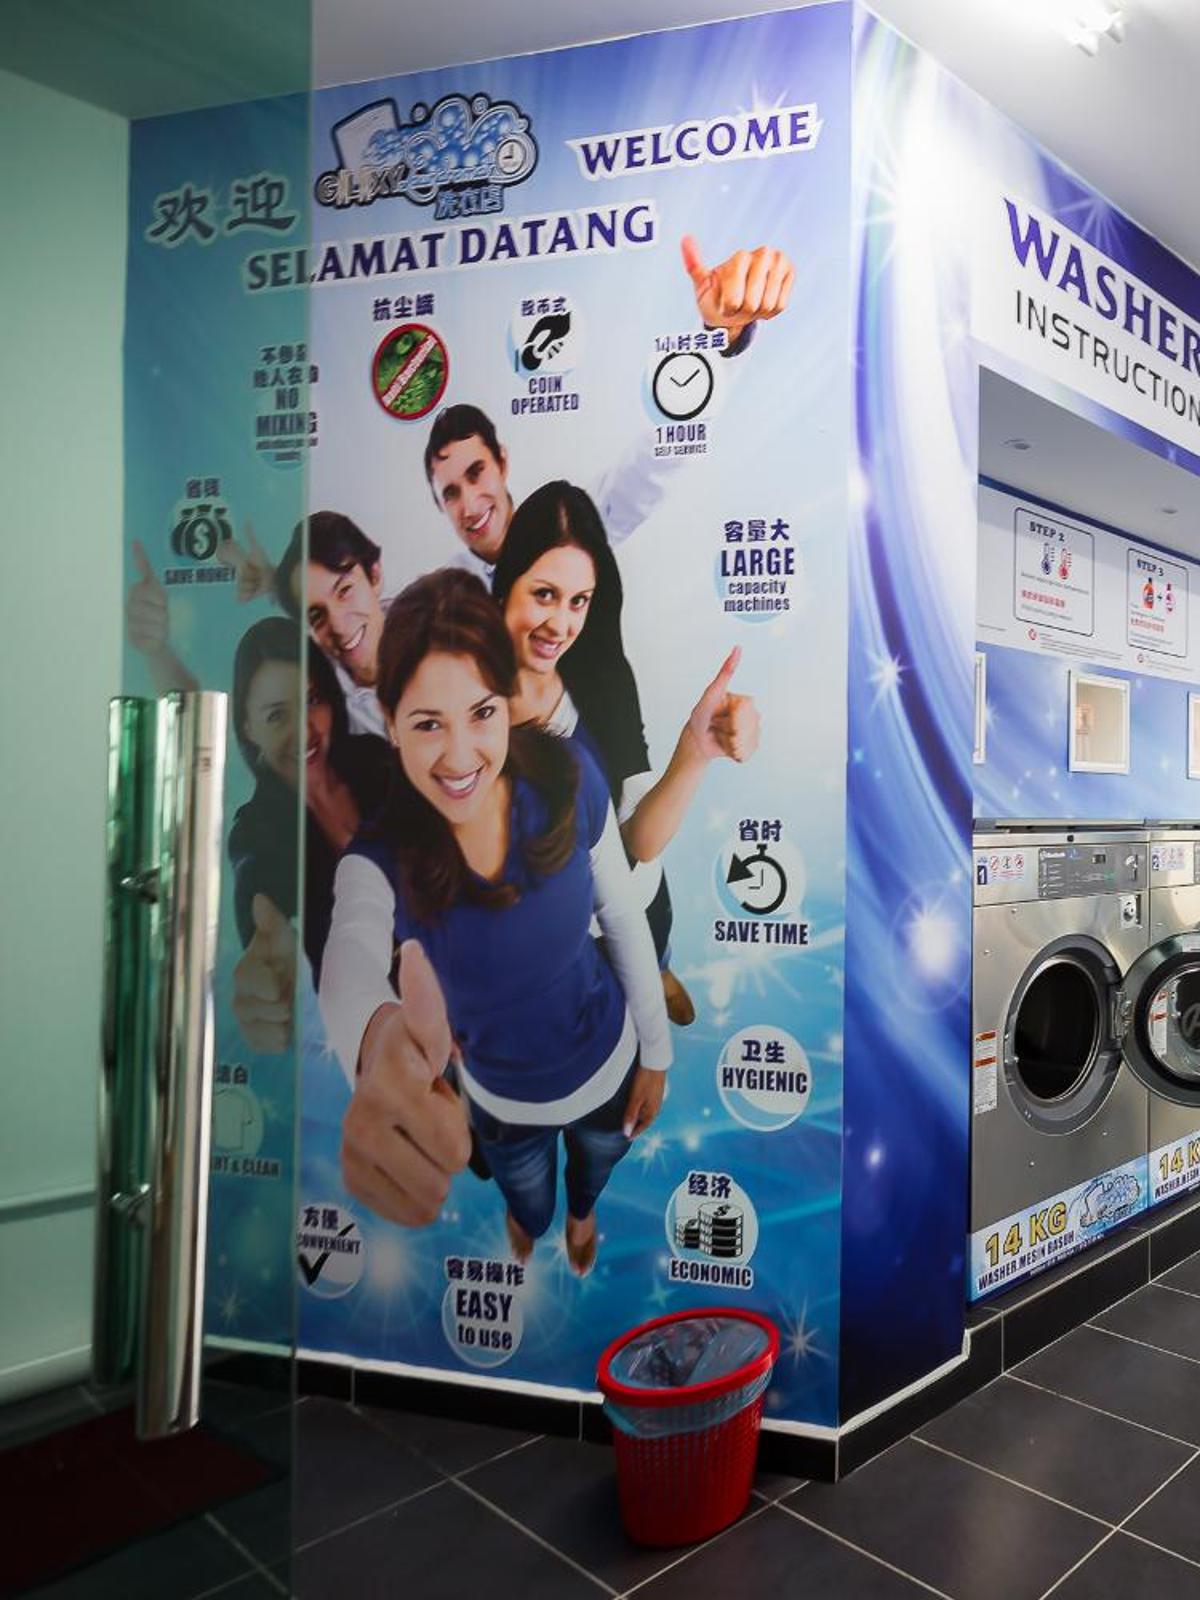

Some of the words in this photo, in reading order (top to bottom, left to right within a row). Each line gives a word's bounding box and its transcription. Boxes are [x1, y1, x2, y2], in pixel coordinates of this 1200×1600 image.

[580, 111, 811, 174] WELCOME
[150, 177, 295, 242] 欢迎
[247, 232, 446, 289] SELAMAT
[459, 206, 654, 265] DATANG
[529, 376, 562, 394] COIN
[511, 394, 579, 415] OPERATED
[667, 424, 706, 442] HOUR
[724, 518, 790, 543] 容量大
[1029, 521, 1057, 538] STEP
[1058, 532, 1065, 541] 2
[721, 547, 795, 577] LARGE
[728, 579, 787, 595] capacity
[724, 597, 790, 612] machines
[740, 819, 782, 842] 省时
[715, 921, 760, 943] SAVE
[763, 923, 809, 945] TIME
[741, 1039, 786, 1063] 卫生
[722, 1066, 808, 1094] HYGIENIC
[1159, 1147, 1185, 1181] 14
[688, 1173, 731, 1199] 经济
[985, 1222, 1023, 1268] 14
[1029, 1201, 1066, 1247] KG
[447, 1258, 525, 1287] 容易操作
[671, 1259, 751, 1287] ECONOMIC
[979, 1260, 1017, 1291] WASHER
[456, 1289, 512, 1322] EASY
[458, 1323, 475, 1345] to
[480, 1328, 512, 1350] use
